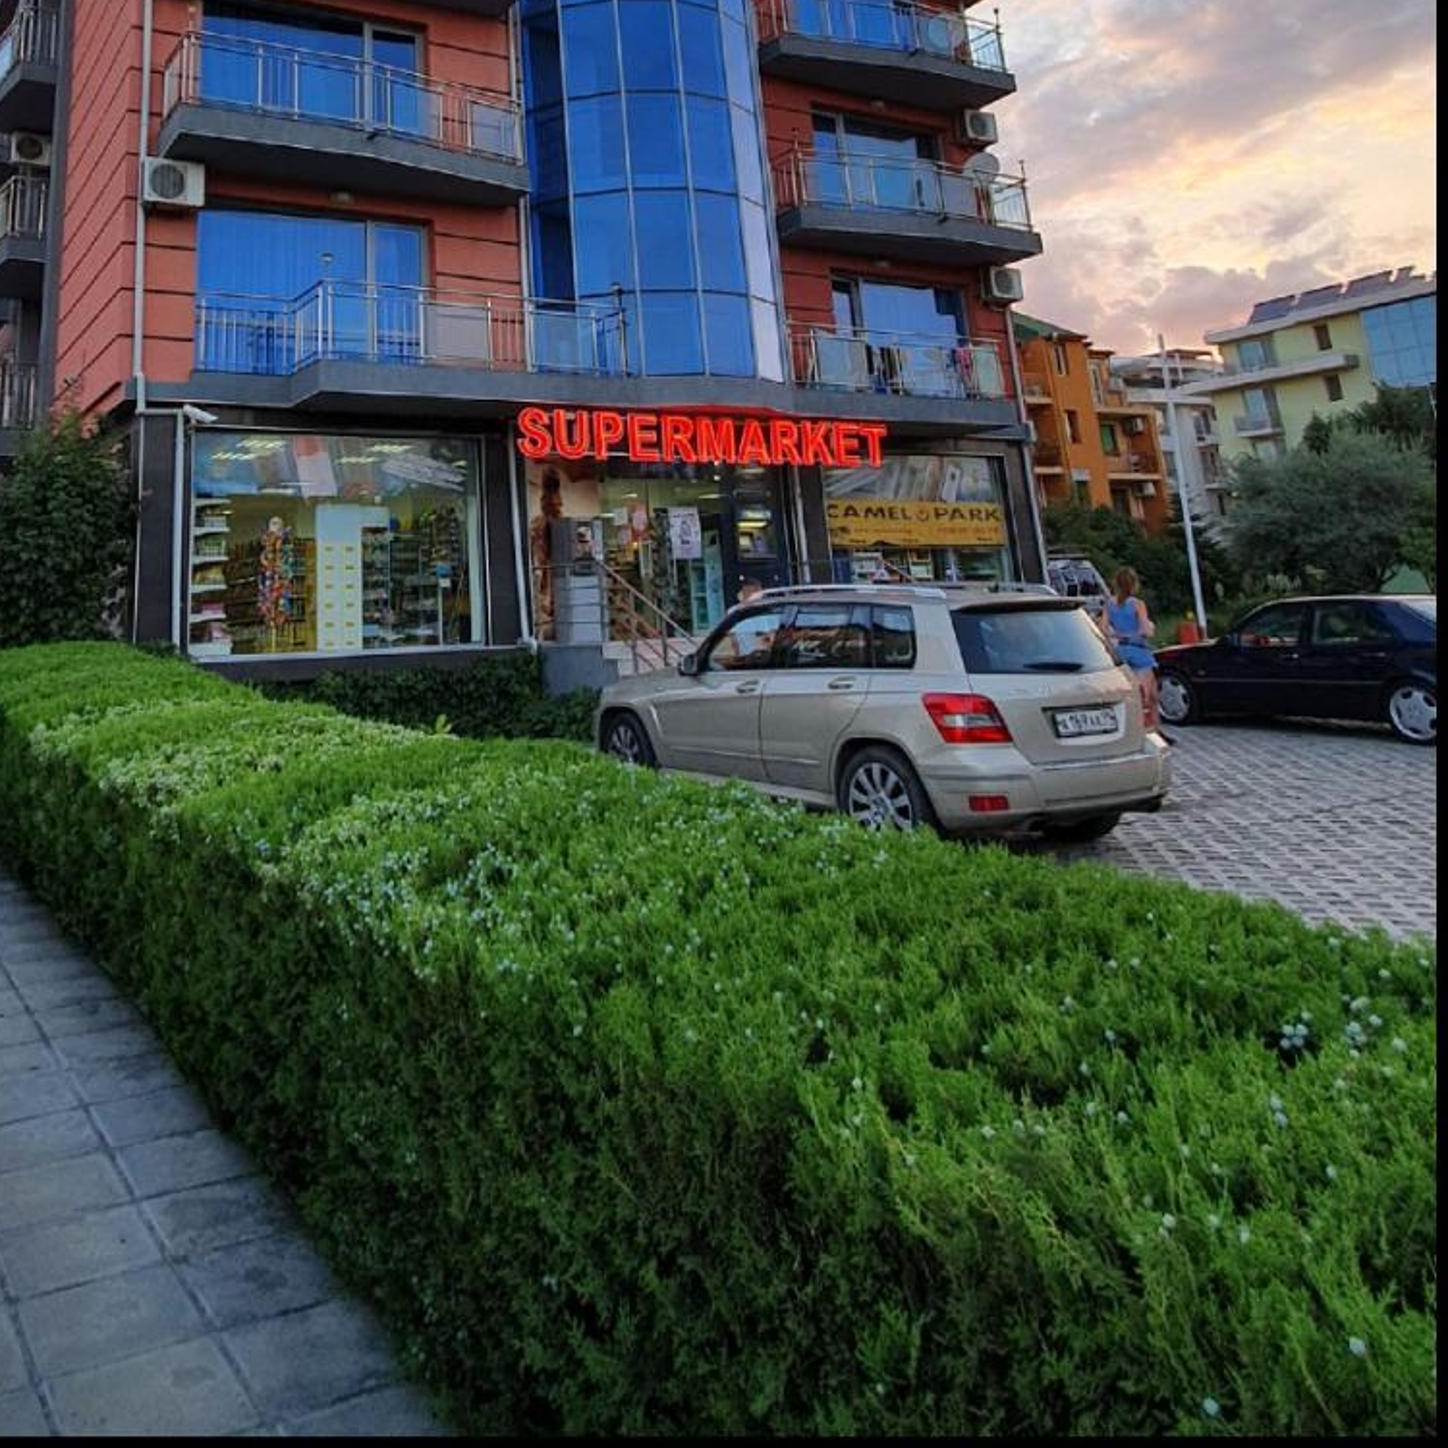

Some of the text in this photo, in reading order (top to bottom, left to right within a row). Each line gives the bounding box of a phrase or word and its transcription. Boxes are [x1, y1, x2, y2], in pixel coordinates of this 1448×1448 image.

[517, 407, 887, 468] SUPERMARKET
[826, 503, 1000, 522] CAMEL PARK
